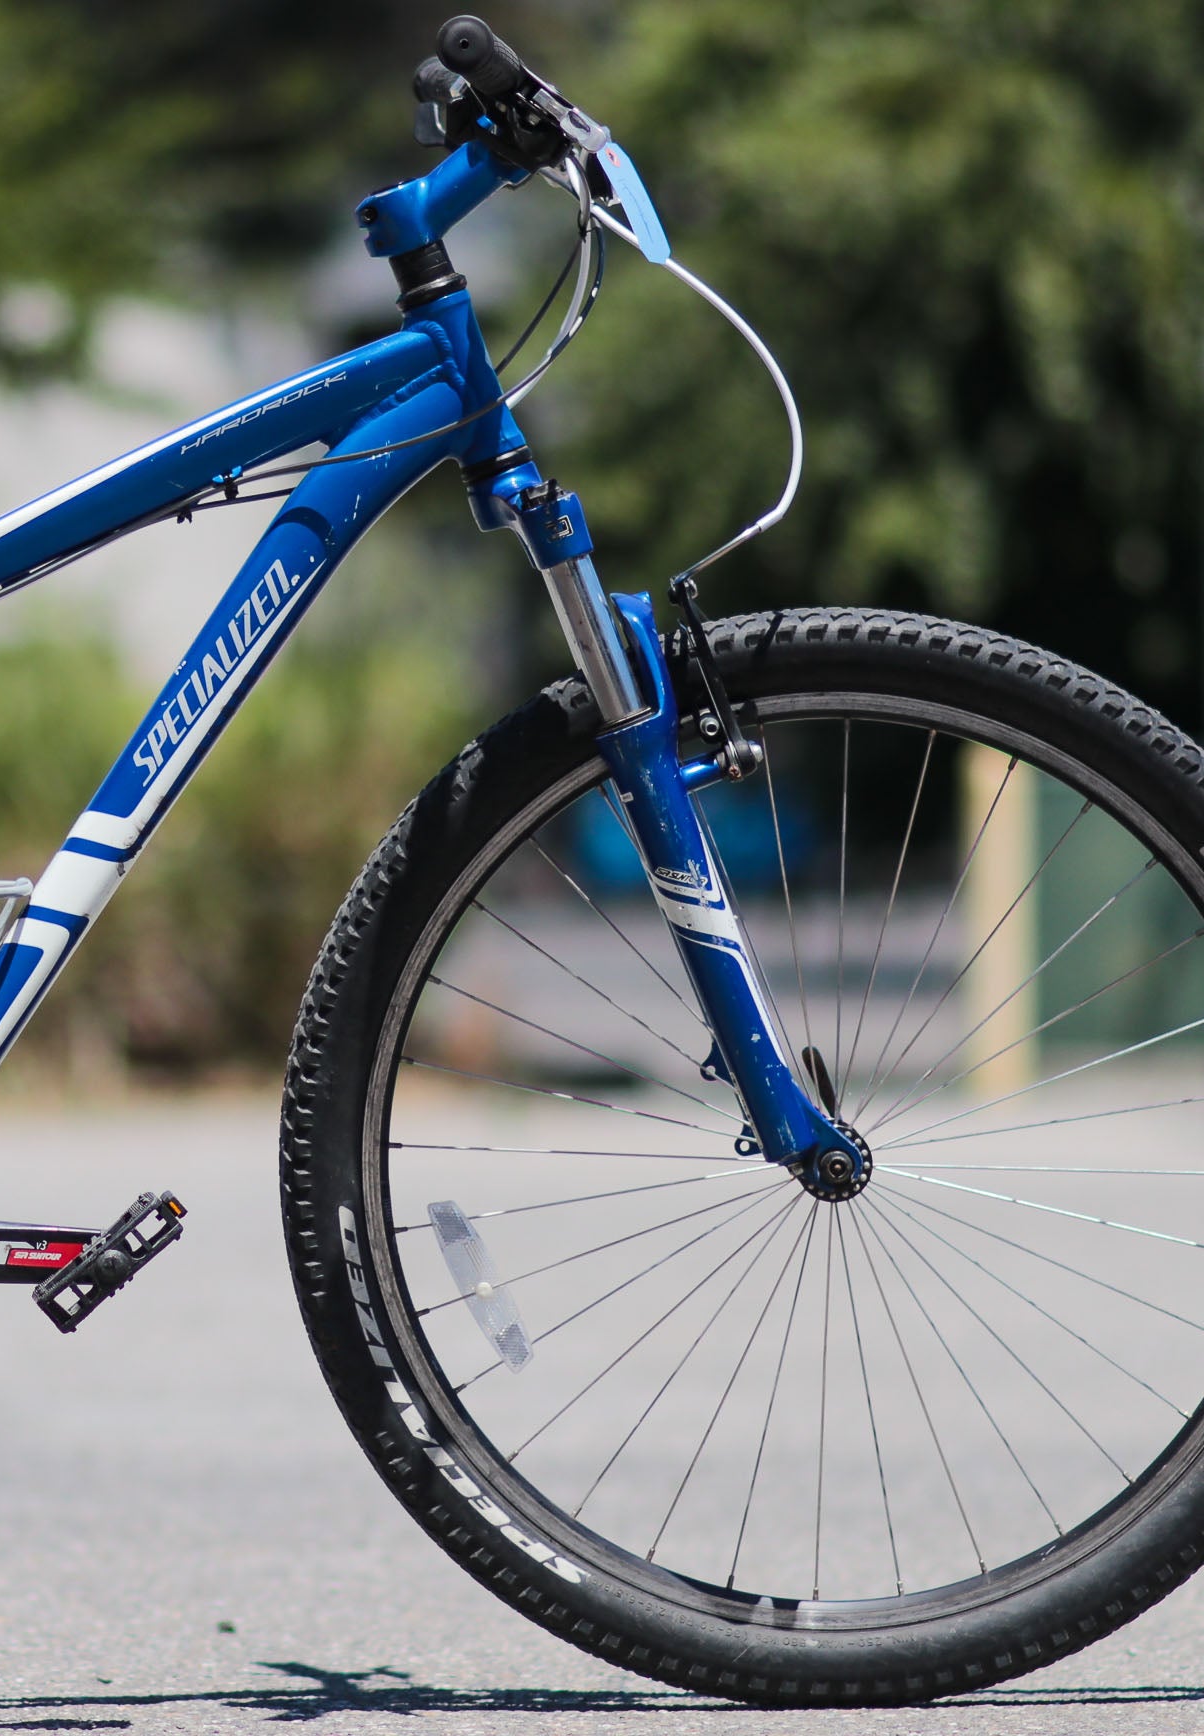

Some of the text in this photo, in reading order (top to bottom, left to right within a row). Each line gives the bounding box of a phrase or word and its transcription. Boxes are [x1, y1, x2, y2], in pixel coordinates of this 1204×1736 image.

[181, 371, 346, 455] HARDROCK
[27, 1251, 62, 1261] SUNTOUR
[338, 1205, 590, 1584] SPECIALIZED
